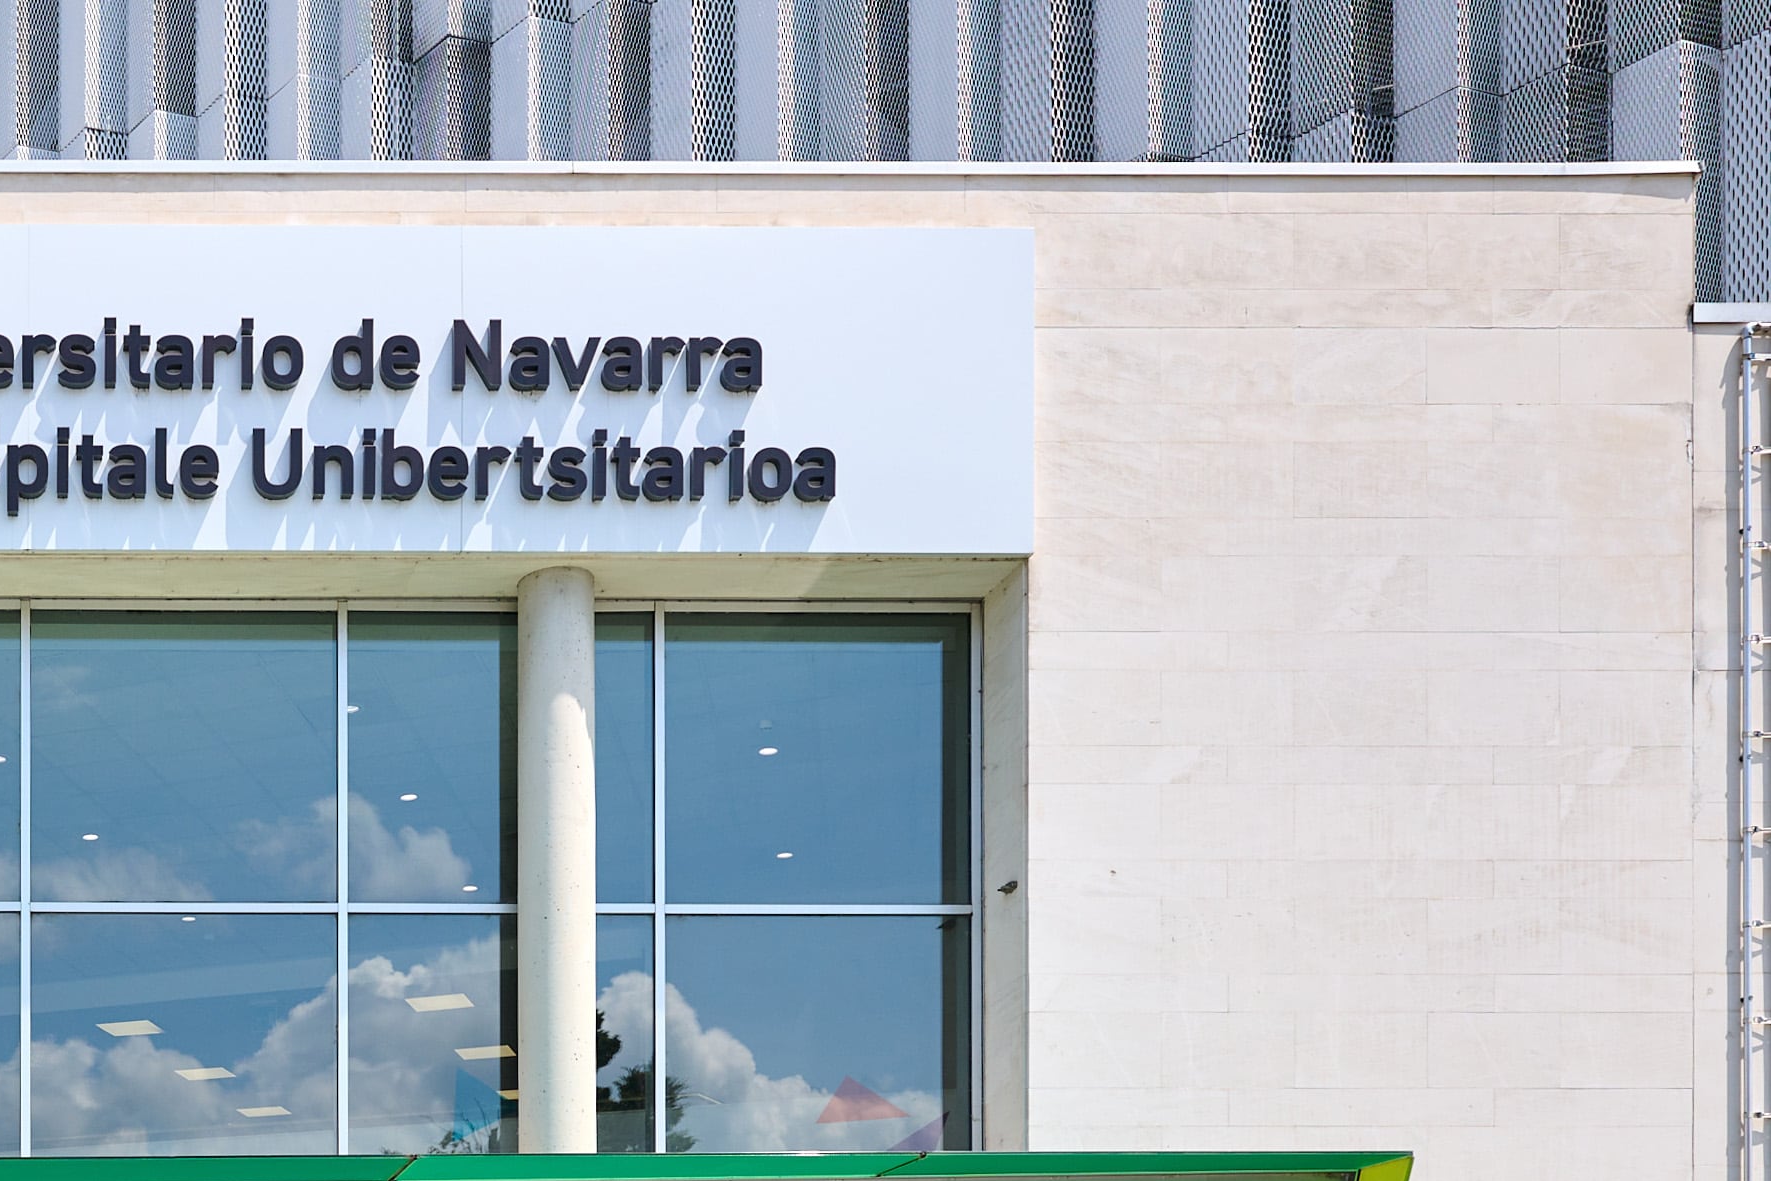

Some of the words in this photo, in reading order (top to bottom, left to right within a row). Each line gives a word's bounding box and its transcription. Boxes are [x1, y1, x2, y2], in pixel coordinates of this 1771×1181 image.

[331, 319, 420, 391] de
[452, 320, 762, 392] Navarra
[253, 429, 835, 502] Unibertsitarioa
